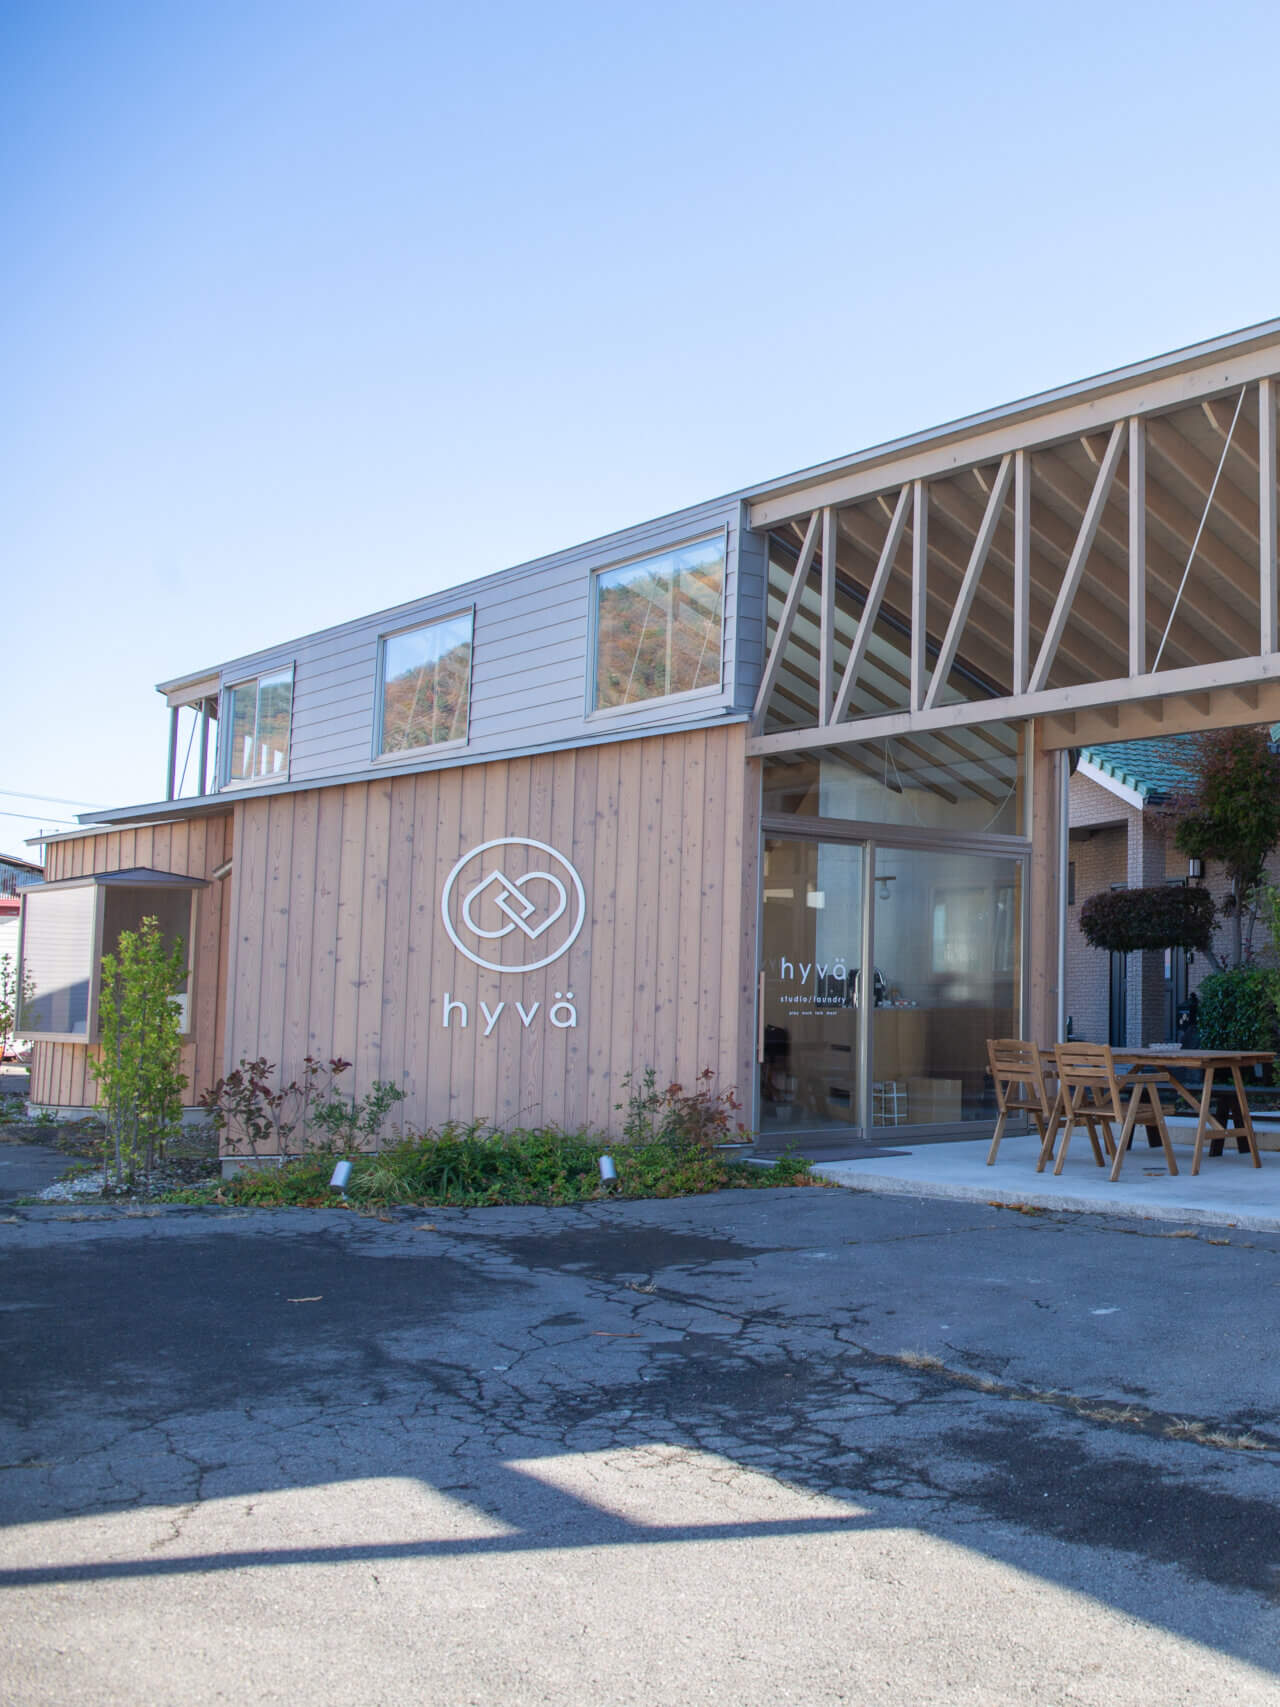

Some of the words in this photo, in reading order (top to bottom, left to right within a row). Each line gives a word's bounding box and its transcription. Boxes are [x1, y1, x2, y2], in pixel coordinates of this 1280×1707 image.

[780, 956, 847, 985] hyvä
[442, 991, 577, 1036] hyvä
[780, 995, 846, 1004] studio/laundry
